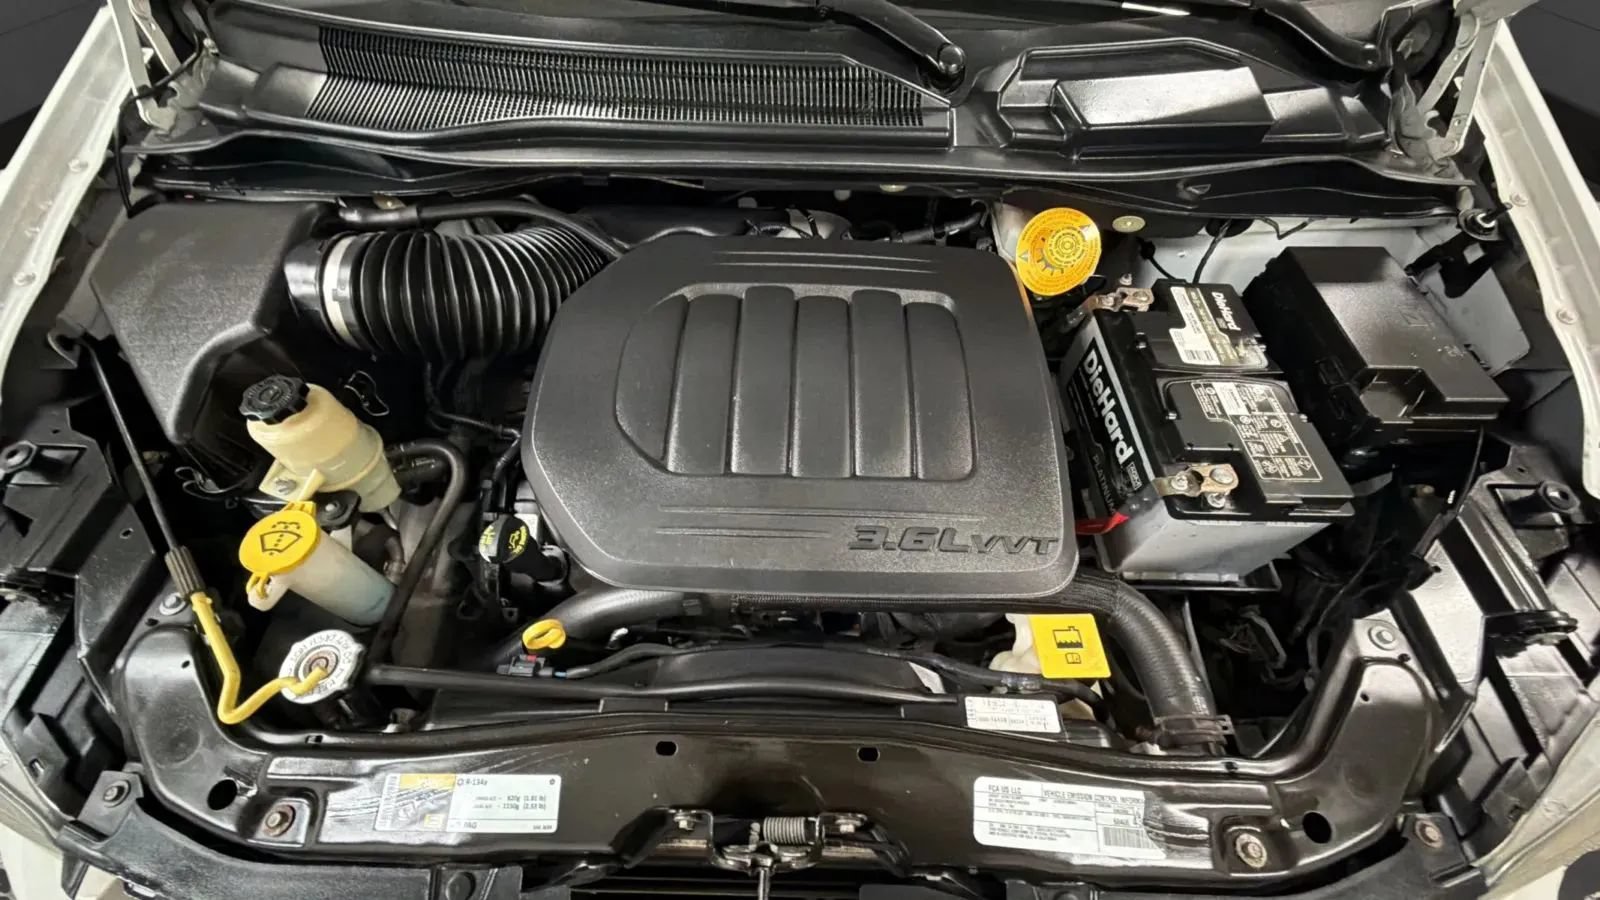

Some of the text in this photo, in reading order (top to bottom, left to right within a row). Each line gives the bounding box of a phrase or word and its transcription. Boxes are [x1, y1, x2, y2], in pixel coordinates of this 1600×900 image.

[1211, 291, 1242, 331] DieHard
[1083, 349, 1134, 465] DieHard
[988, 784, 1000, 793] FCA
[1011, 786, 1022, 795] LLC
[1044, 790, 1066, 799] VEHICLE
[1067, 792, 1093, 801] EMISSION
[1095, 794, 1117, 802] CONTROL
